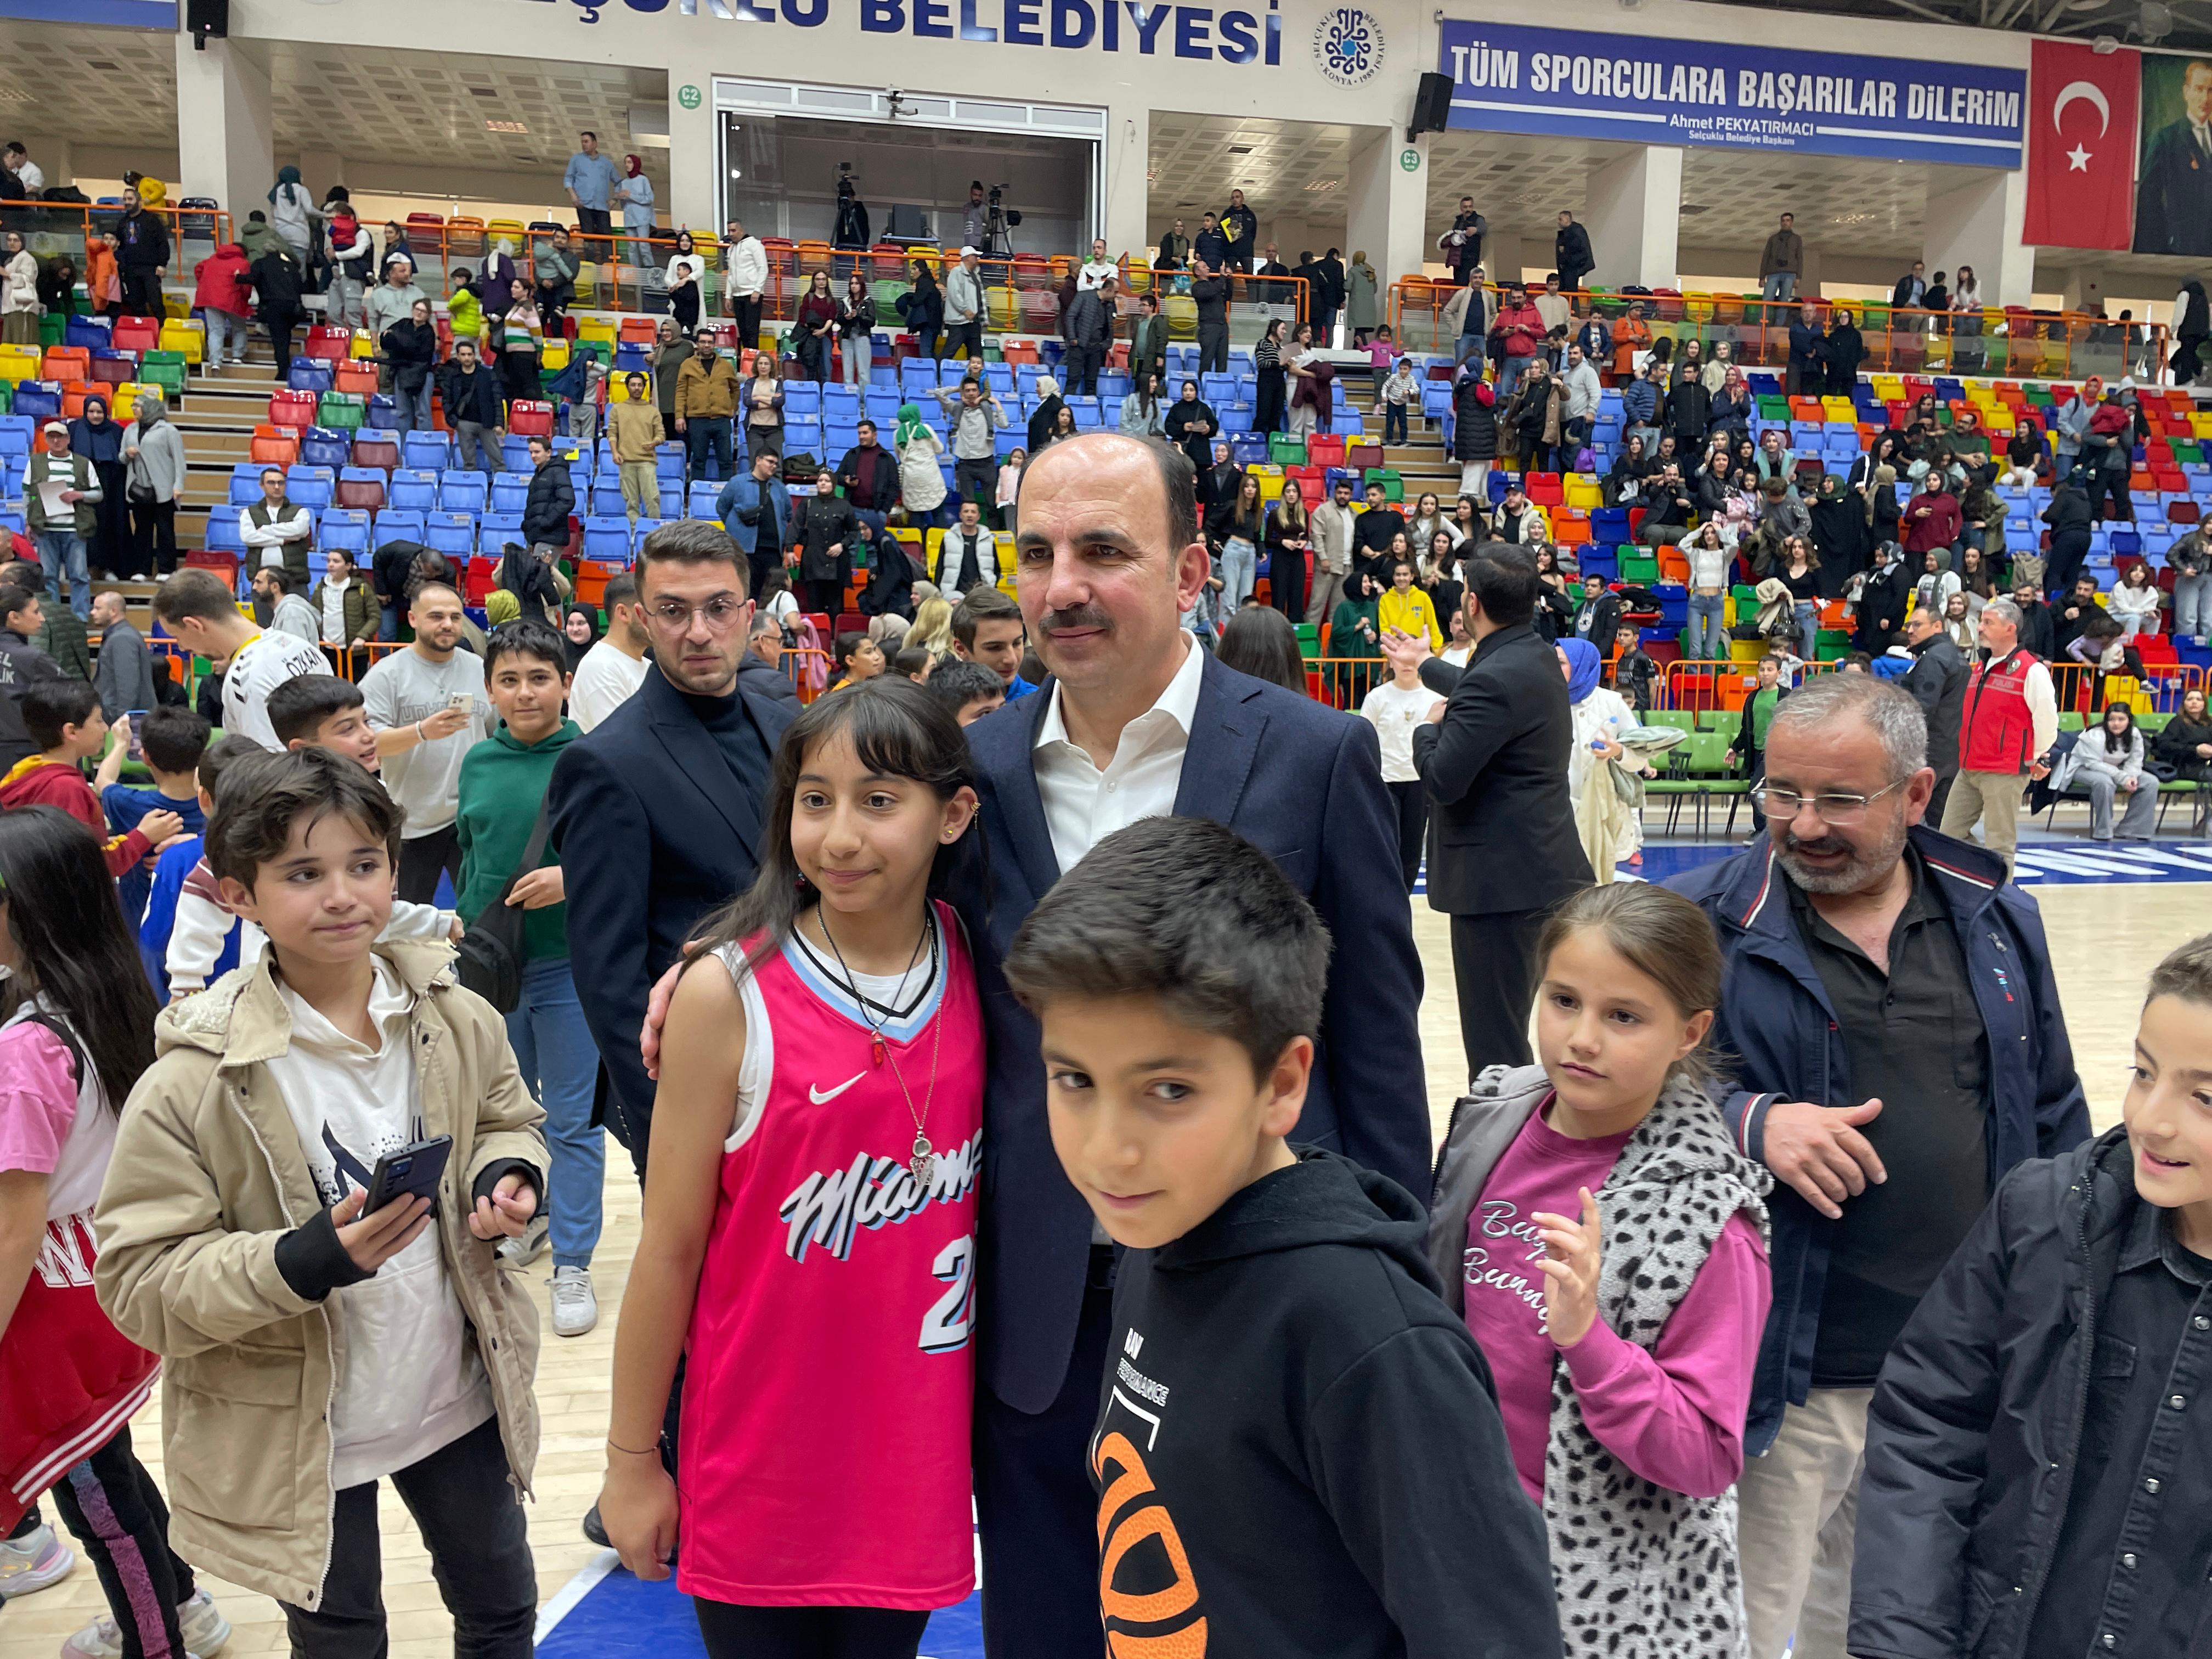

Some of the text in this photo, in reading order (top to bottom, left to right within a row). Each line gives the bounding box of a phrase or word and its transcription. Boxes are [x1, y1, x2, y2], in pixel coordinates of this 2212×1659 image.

[1323, 66, 1352, 86] KONYA
[1451, 41, 1519, 89] TÜM
[1531, 53, 1726, 105] SPORCULARA
[1737, 70, 1897, 117] BAŞARILAR
[682, 87, 698, 100] C2
[1669, 114, 1814, 136] Ahmet PEKYATIRMACI
[1689, 129, 1724, 142] Selçuklu
[1725, 133, 1761, 145] Belediye
[1404, 152, 1418, 164] C3
